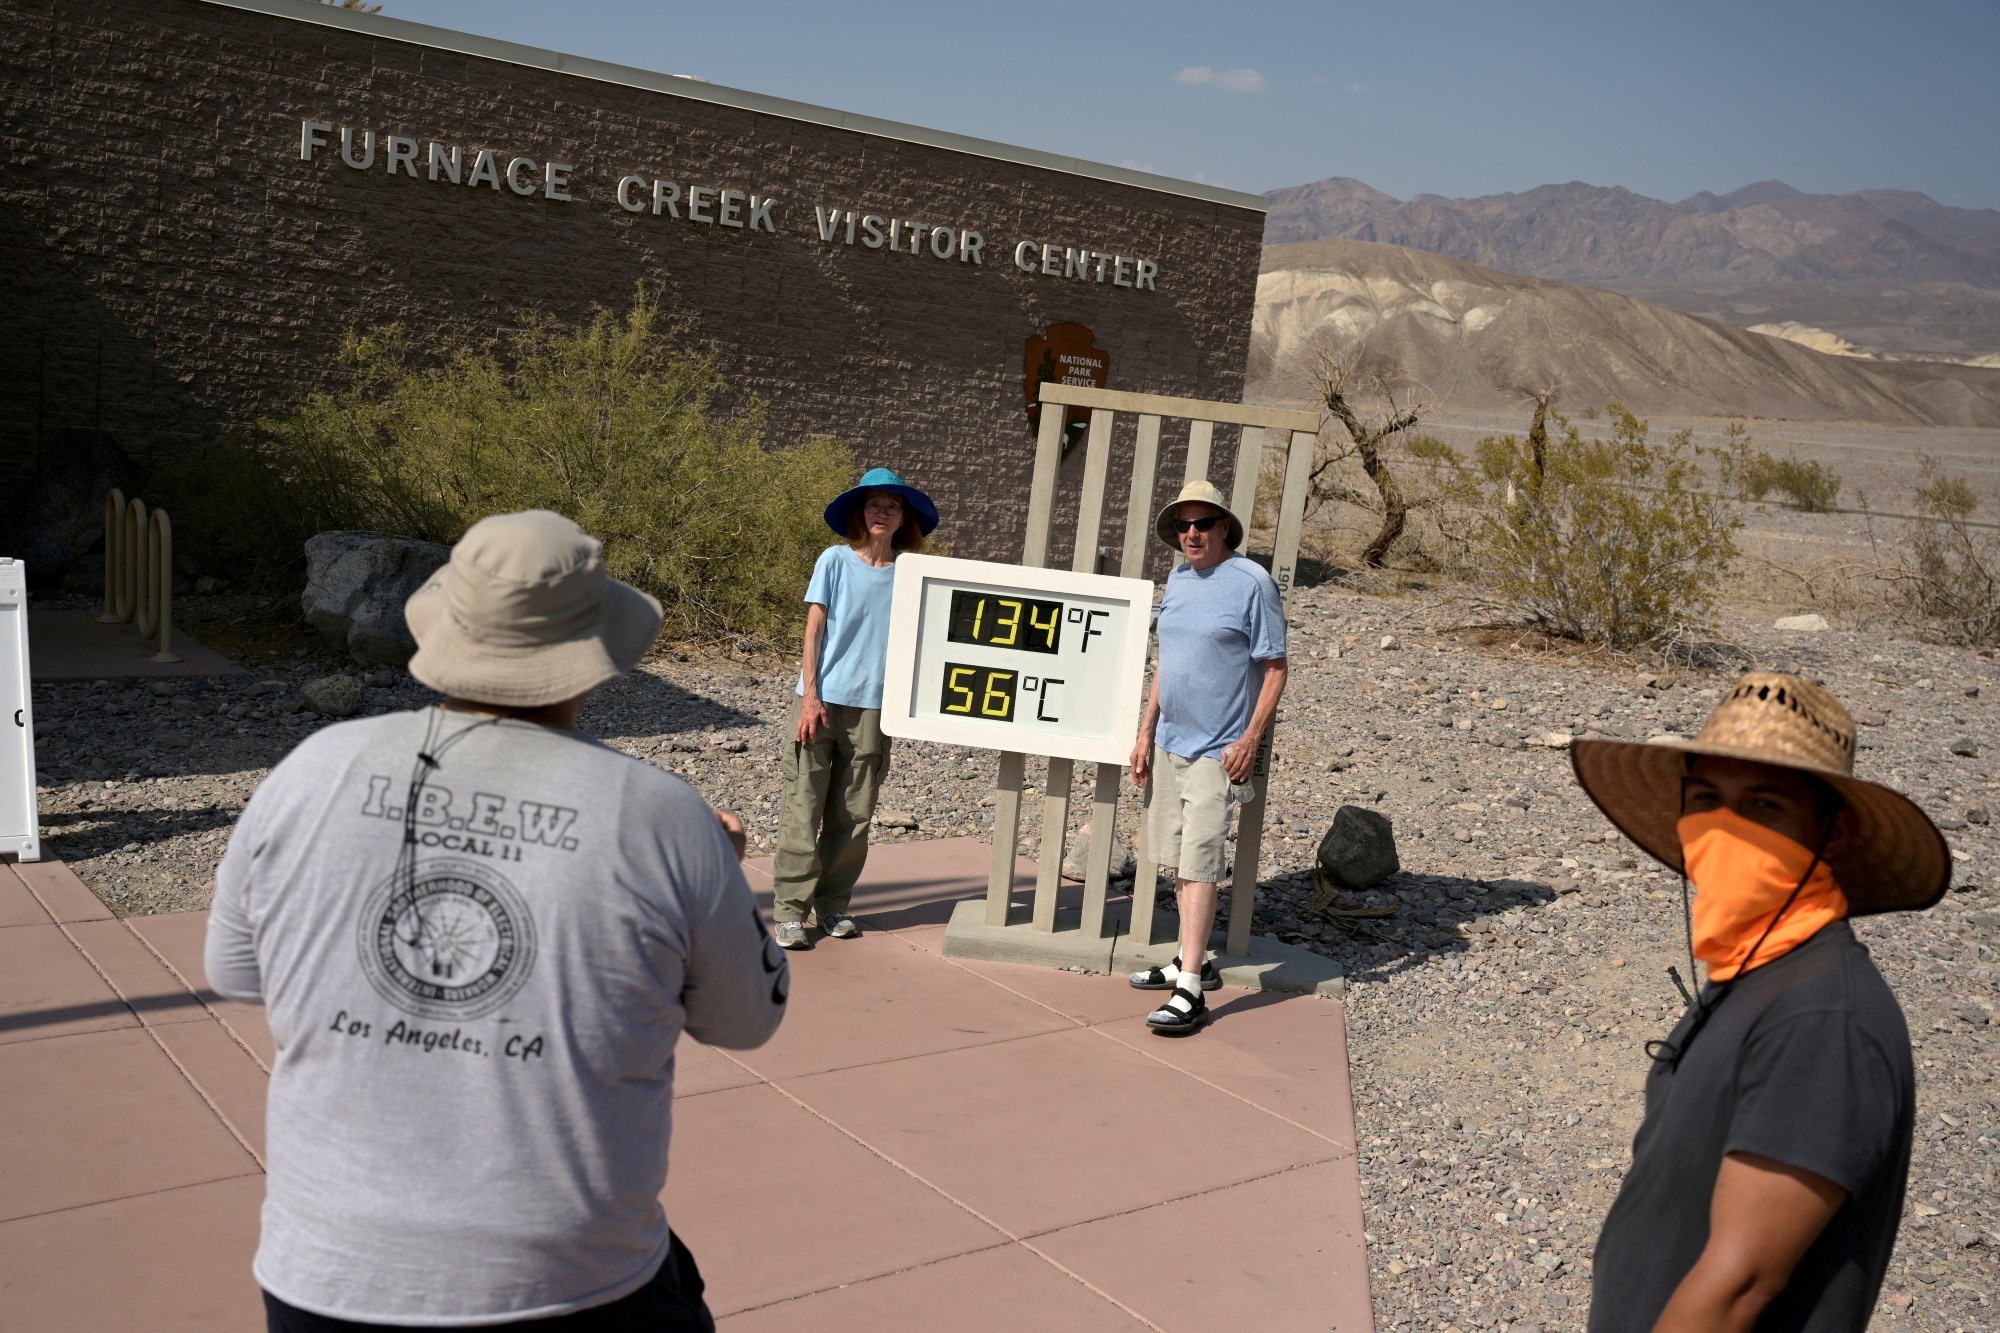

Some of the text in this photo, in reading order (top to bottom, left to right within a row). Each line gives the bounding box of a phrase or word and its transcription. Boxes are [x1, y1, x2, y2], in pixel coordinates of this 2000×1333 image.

[299, 119, 1160, 293] FURNACE CREEK VISITOR CENTER
[1060, 355, 1103, 368] NATIONAL
[1069, 367, 1092, 377] PARK
[1061, 375, 1097, 388] SERVICE
[1277, 565, 1291, 592] 190
[361, 774, 580, 852] I.B.E.W.
[329, 1009, 372, 1039] Los
[504, 1033, 545, 1062] CA
